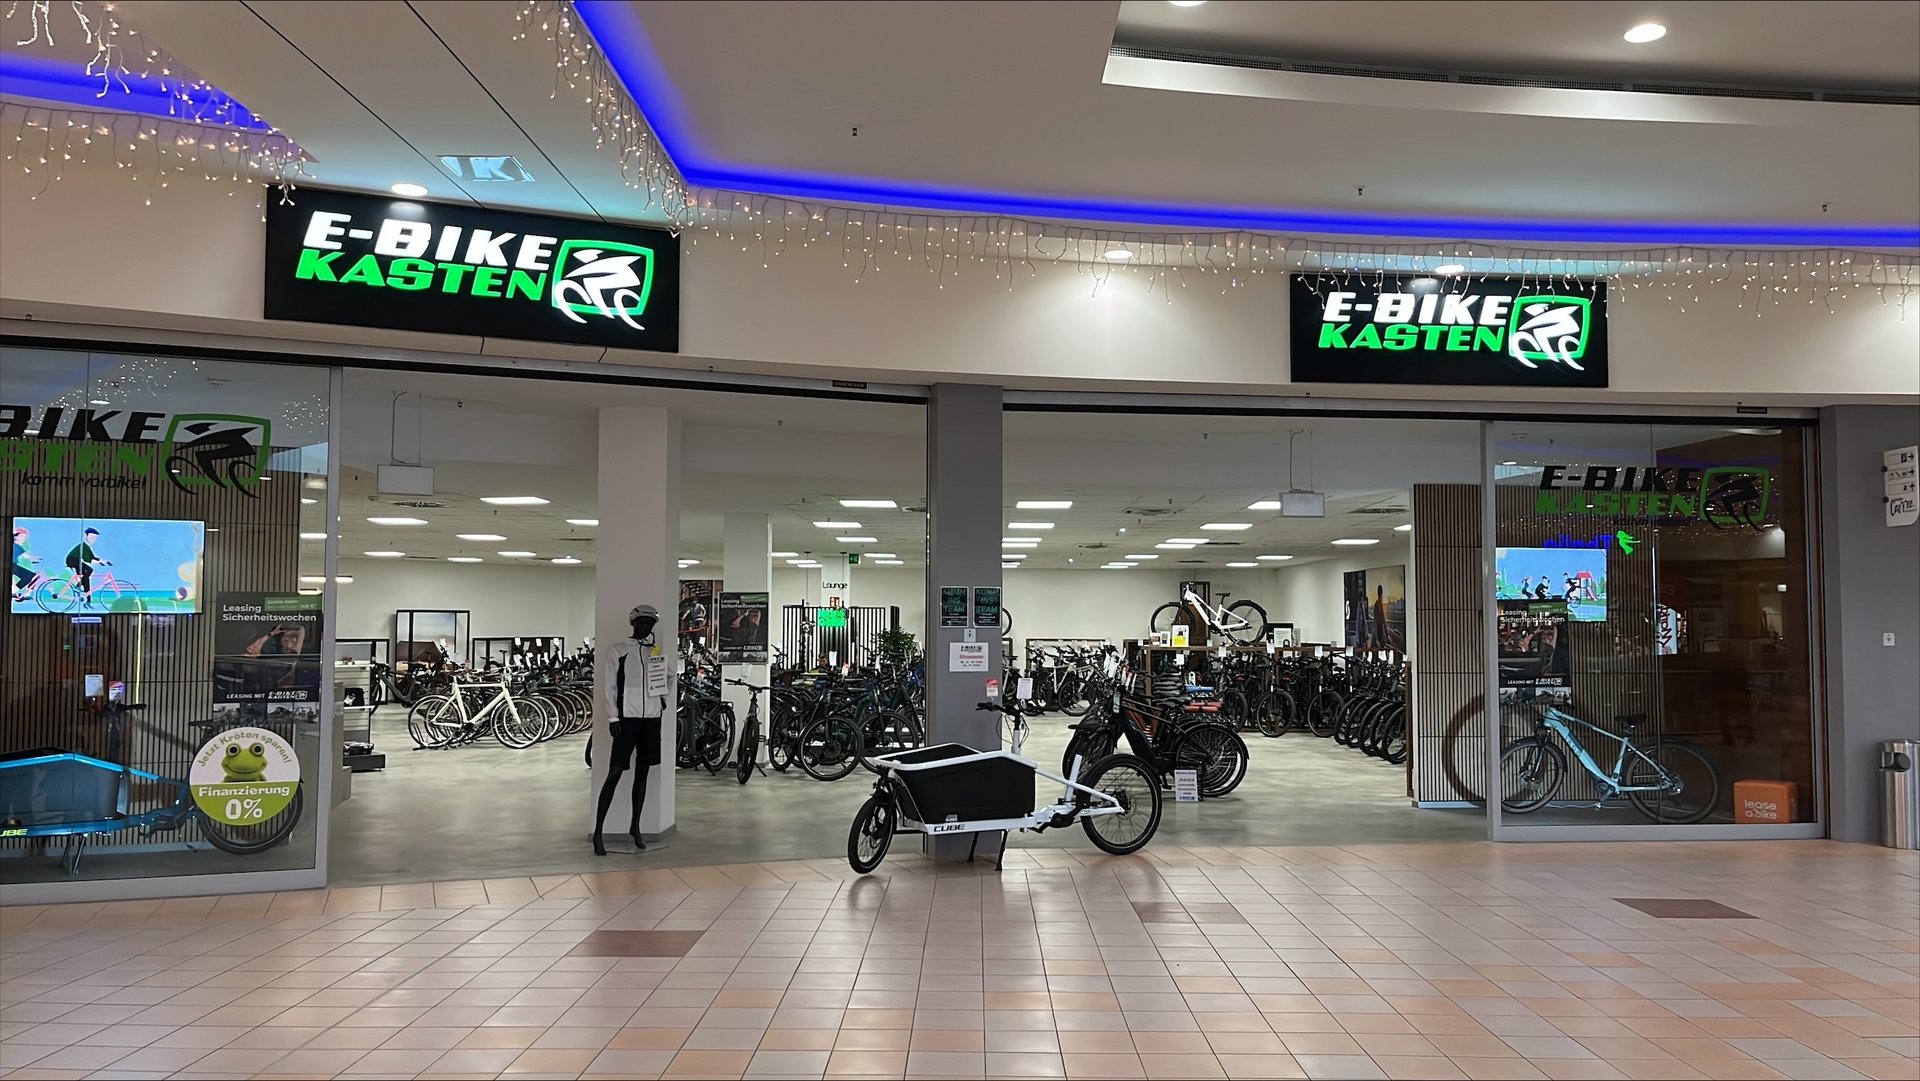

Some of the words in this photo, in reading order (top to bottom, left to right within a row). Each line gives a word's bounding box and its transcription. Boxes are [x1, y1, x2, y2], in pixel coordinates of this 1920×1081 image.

[303, 211, 557, 270] E-BIKE
[295, 249, 546, 301] KASTEN
[1322, 291, 1512, 325] E-BIKE
[1318, 323, 1505, 352] KASTEN
[1539, 466, 1701, 491] E-BIKE
[1535, 493, 1697, 516] KASTEN
[822, 581, 848, 590] Lounge
[222, 613, 317, 622] Sicherheitswochen
[223, 604, 262, 613] Leasing
[198, 786, 290, 796] Finanzierung
[225, 798, 263, 819] 0%
[1744, 799, 1777, 810] lease
[933, 824, 965, 832] CUBE
